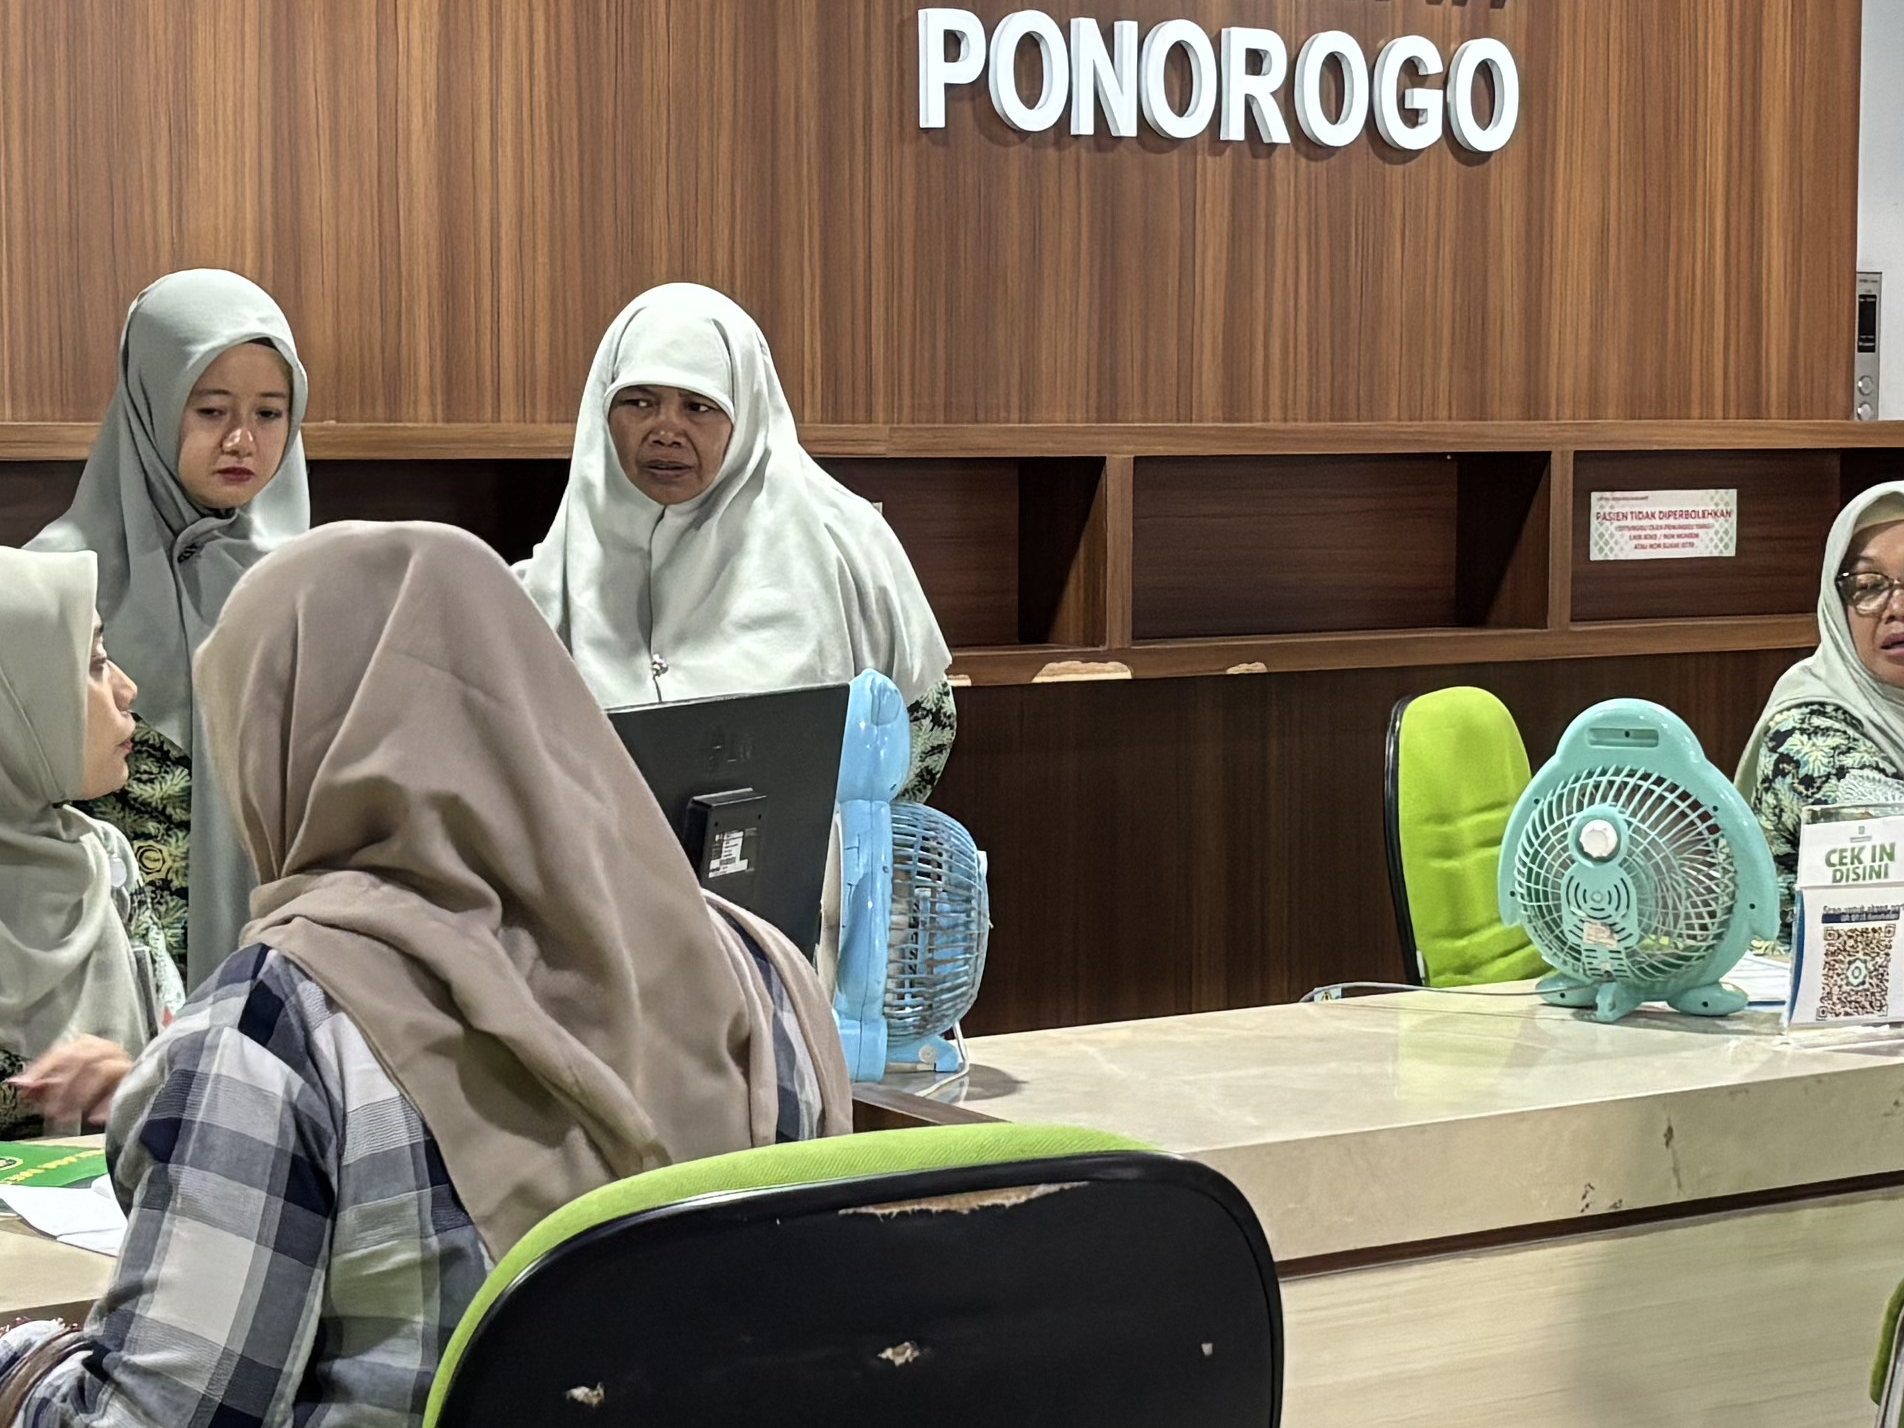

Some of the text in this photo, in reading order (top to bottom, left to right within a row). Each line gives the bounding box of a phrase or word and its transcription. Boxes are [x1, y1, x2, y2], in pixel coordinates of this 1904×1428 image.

[918, 6, 1520, 154] PONOROGO
[1596, 508, 1732, 522] PASIEN TIDAK DIPERBOLEHKAN
[1825, 842, 1896, 868] CEK IN
[1832, 863, 1889, 883] DISINI
